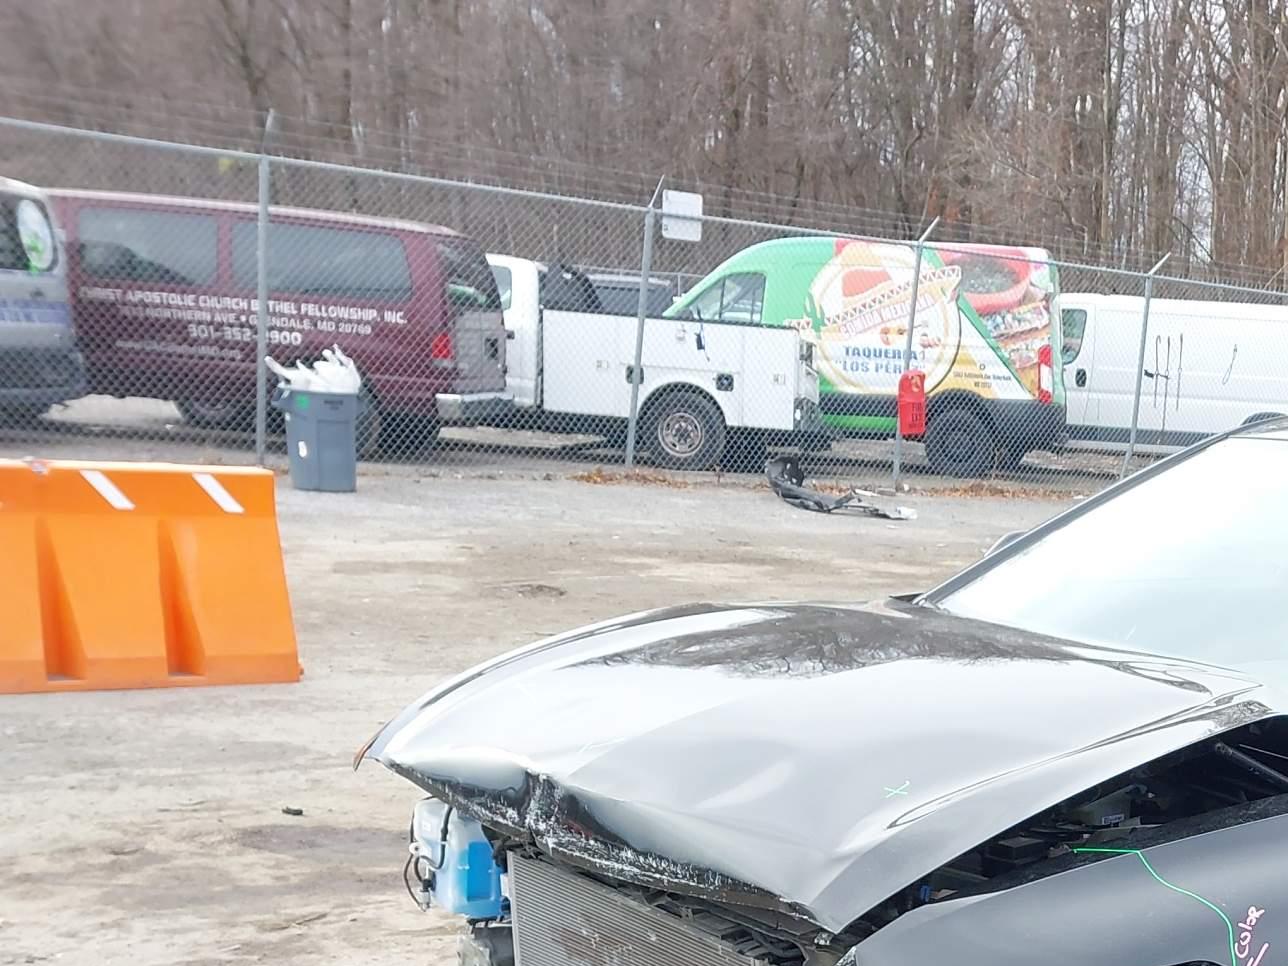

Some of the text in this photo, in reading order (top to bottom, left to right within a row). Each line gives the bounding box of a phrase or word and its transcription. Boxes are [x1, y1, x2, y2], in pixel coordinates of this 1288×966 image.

[126, 289, 196, 307] APOSTOLIC
[198, 294, 248, 311] CHURCH
[250, 298, 298, 316] BTHEL
[383, 309, 408, 324] INC.
[187, 323, 303, 346] 301-352-900
[317, 319, 336, 332] MD
